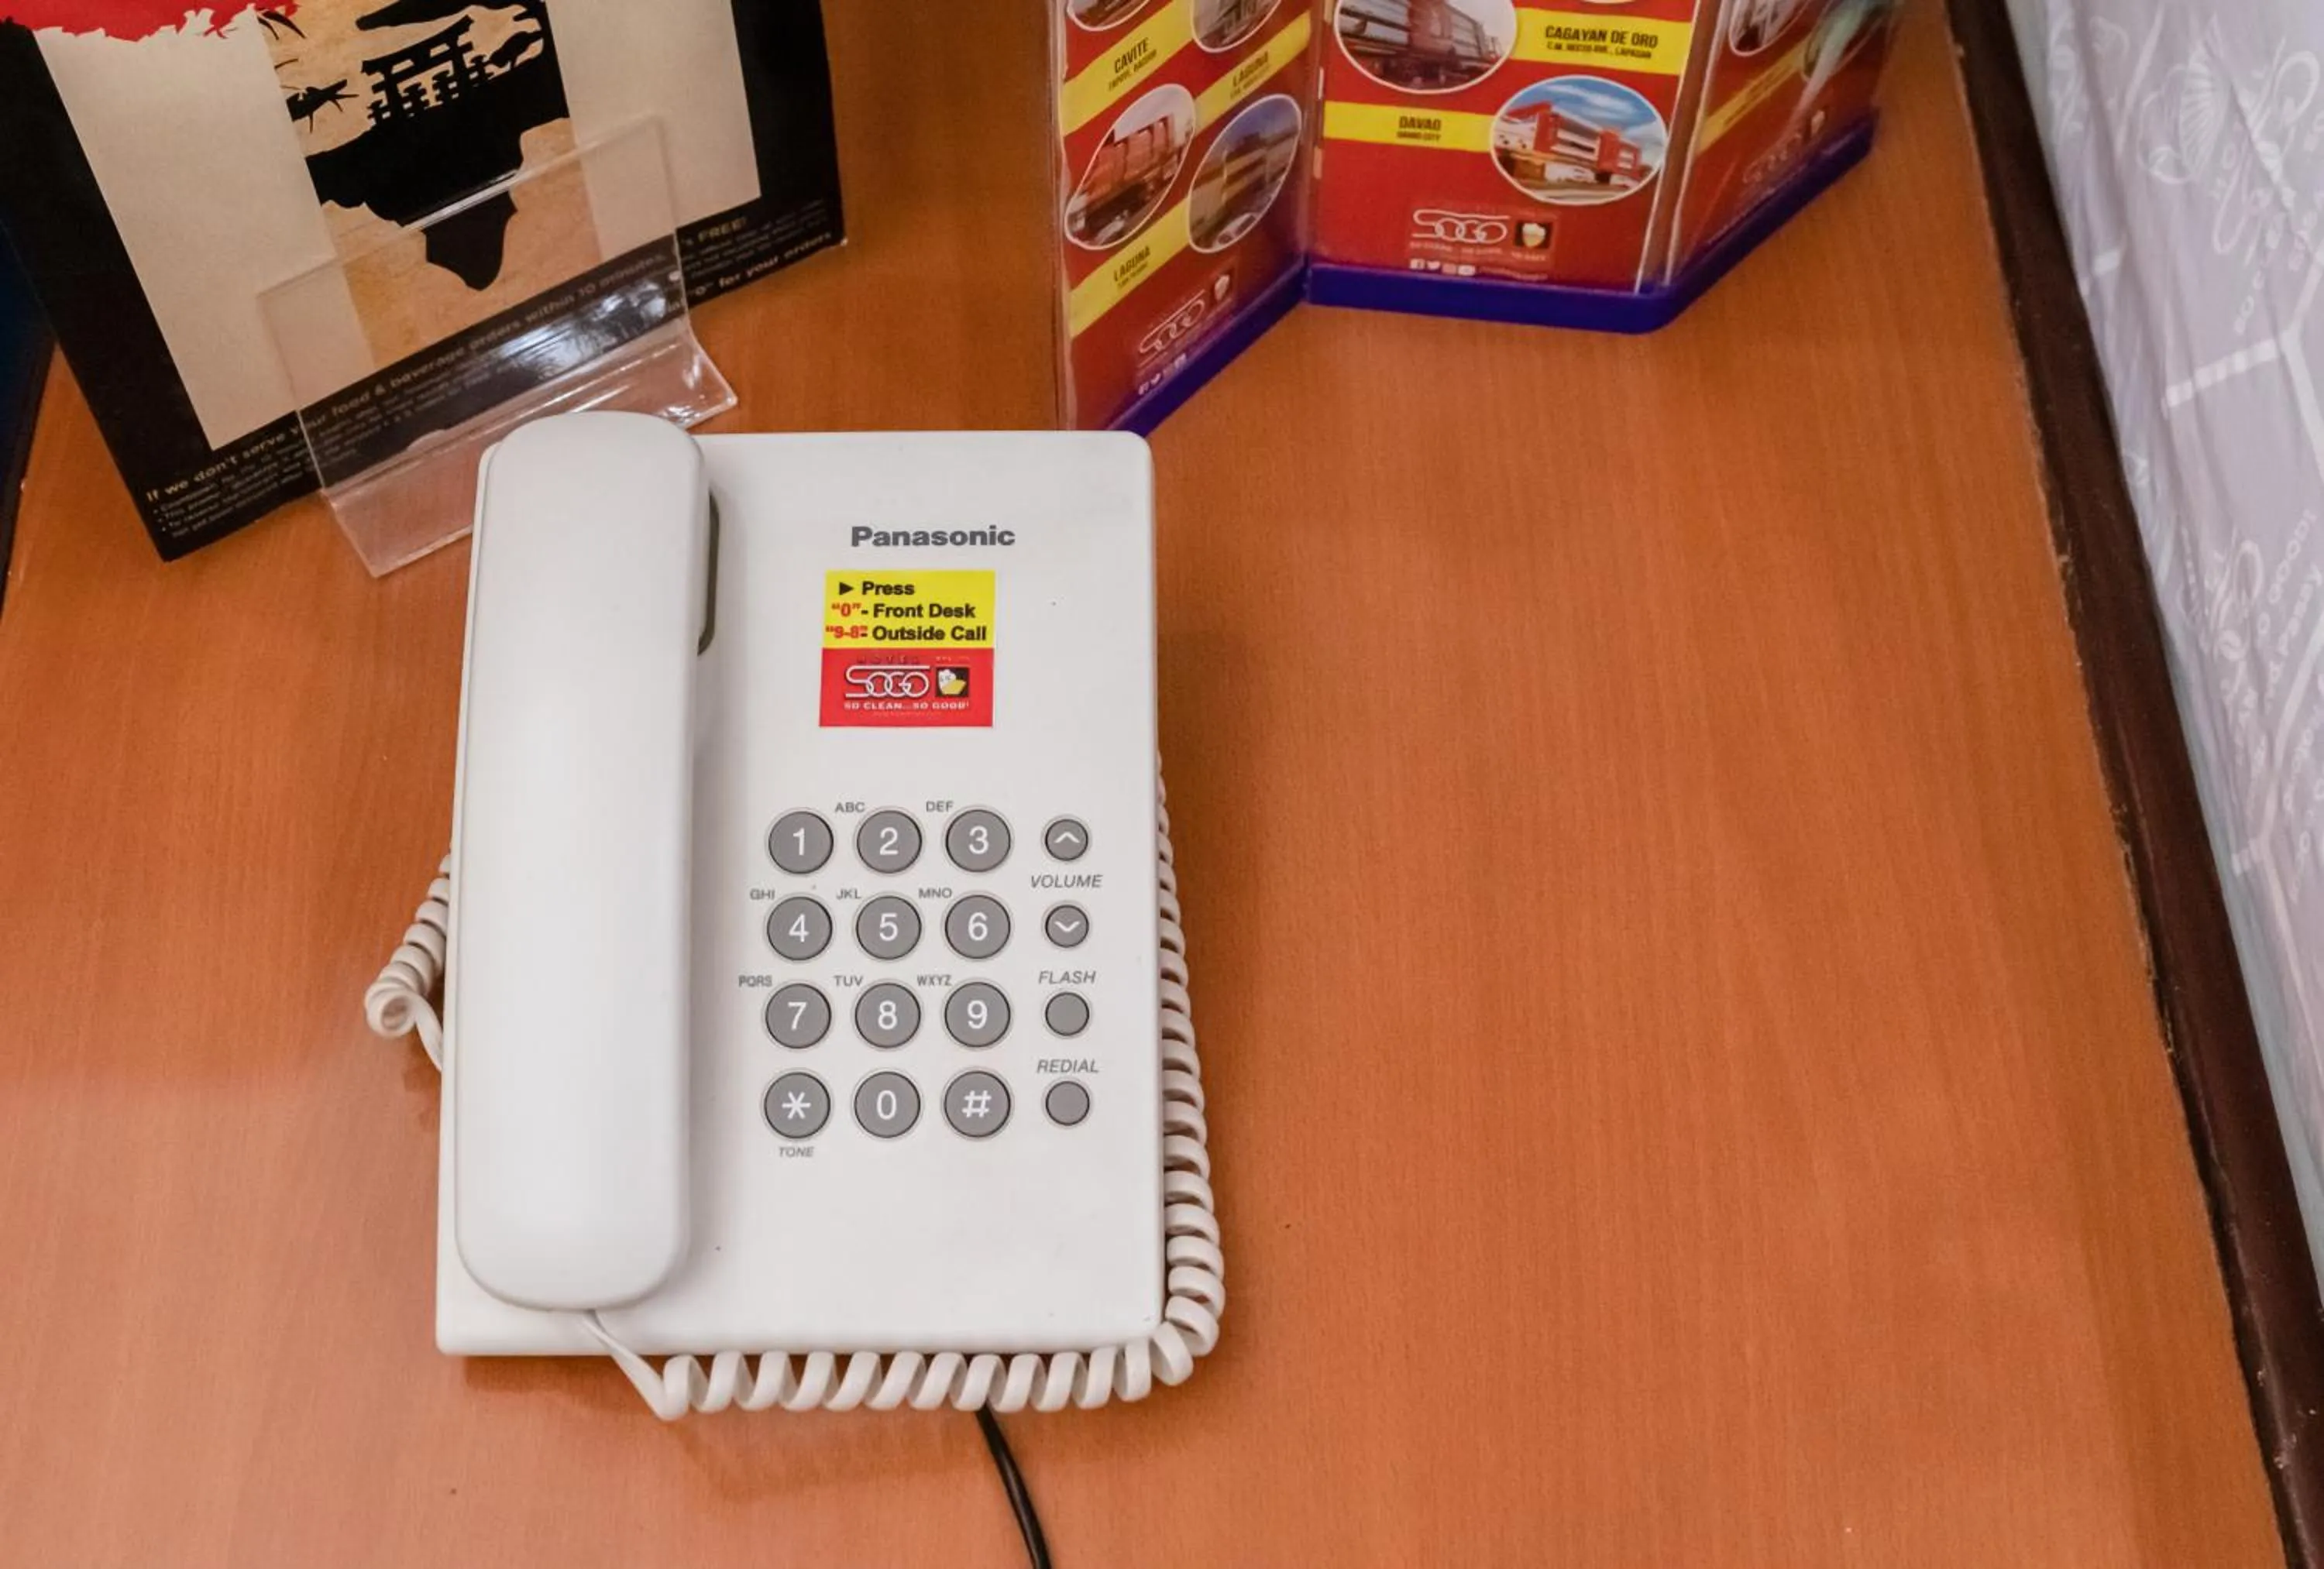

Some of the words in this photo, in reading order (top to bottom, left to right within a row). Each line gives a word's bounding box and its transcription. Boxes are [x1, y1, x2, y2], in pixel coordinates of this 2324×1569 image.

[1545, 25, 1607, 42] CAGAYAN
[1611, 29, 1628, 44] DE
[1631, 33, 1659, 48] ORO
[1114, 38, 1150, 74] CAVITE
[1399, 116, 1442, 131] DAVAO
[718, 273, 741, 288] for
[746, 256, 779, 278] your
[784, 232, 831, 259] orders
[164, 479, 190, 495] we
[193, 455, 238, 483] don't
[242, 432, 286, 458] serve
[332, 392, 371, 417] food
[469, 320, 521, 351] orders
[525, 294, 576, 323] within
[851, 524, 1016, 547] Panasonic
[861, 581, 915, 596] Press
[873, 603, 923, 618] Front
[929, 603, 976, 618] Desk
[872, 625, 945, 641] Outside
[951, 625, 987, 641] Call
[844, 665, 931, 698] SOGO
[835, 802, 865, 813] ABC
[926, 801, 954, 813] DEF
[792, 828, 806, 856] 1
[879, 827, 899, 856] 2
[968, 826, 989, 854] 3
[1030, 874, 1103, 888] VOLUME
[750, 889, 775, 901] GHI
[836, 888, 862, 900] JKL
[918, 888, 952, 899] MNO
[789, 914, 810, 942] 4
[879, 912, 899, 941] 5
[968, 912, 988, 941] 6
[738, 976, 772, 987] PQRS
[834, 976, 864, 987] TUV
[916, 975, 952, 987] WXYZ
[1038, 970, 1096, 984] FLASH
[787, 1001, 807, 1031] 7
[877, 1001, 898, 1030] 8
[967, 1000, 988, 1029] 9
[1037, 1059, 1100, 1073] REDIAL
[876, 1090, 896, 1120] 0
[779, 1146, 814, 1159] TONE
